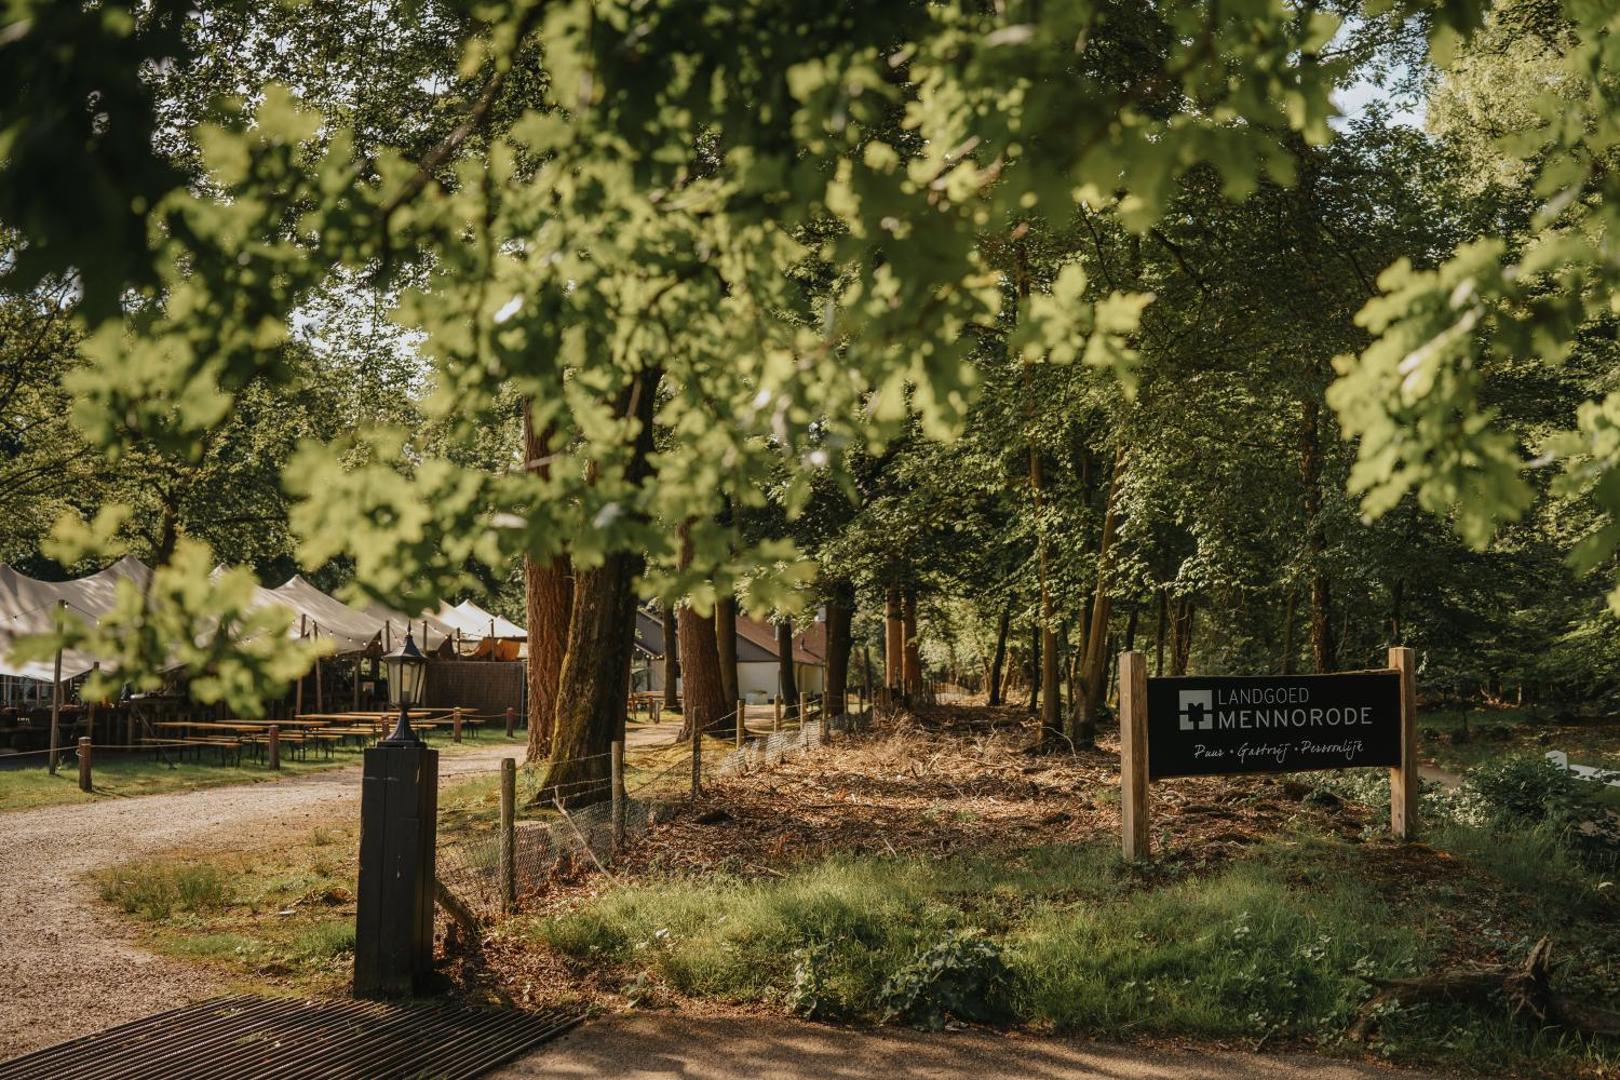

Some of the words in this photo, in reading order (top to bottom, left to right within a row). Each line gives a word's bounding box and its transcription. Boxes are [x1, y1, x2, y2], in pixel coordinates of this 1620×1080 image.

[1218, 687, 1310, 705] LANDGOED
[1218, 707, 1372, 729] MENNORODE
[1194, 744, 1225, 759] Puur
[1237, 742, 1291, 764] Gastvrij
